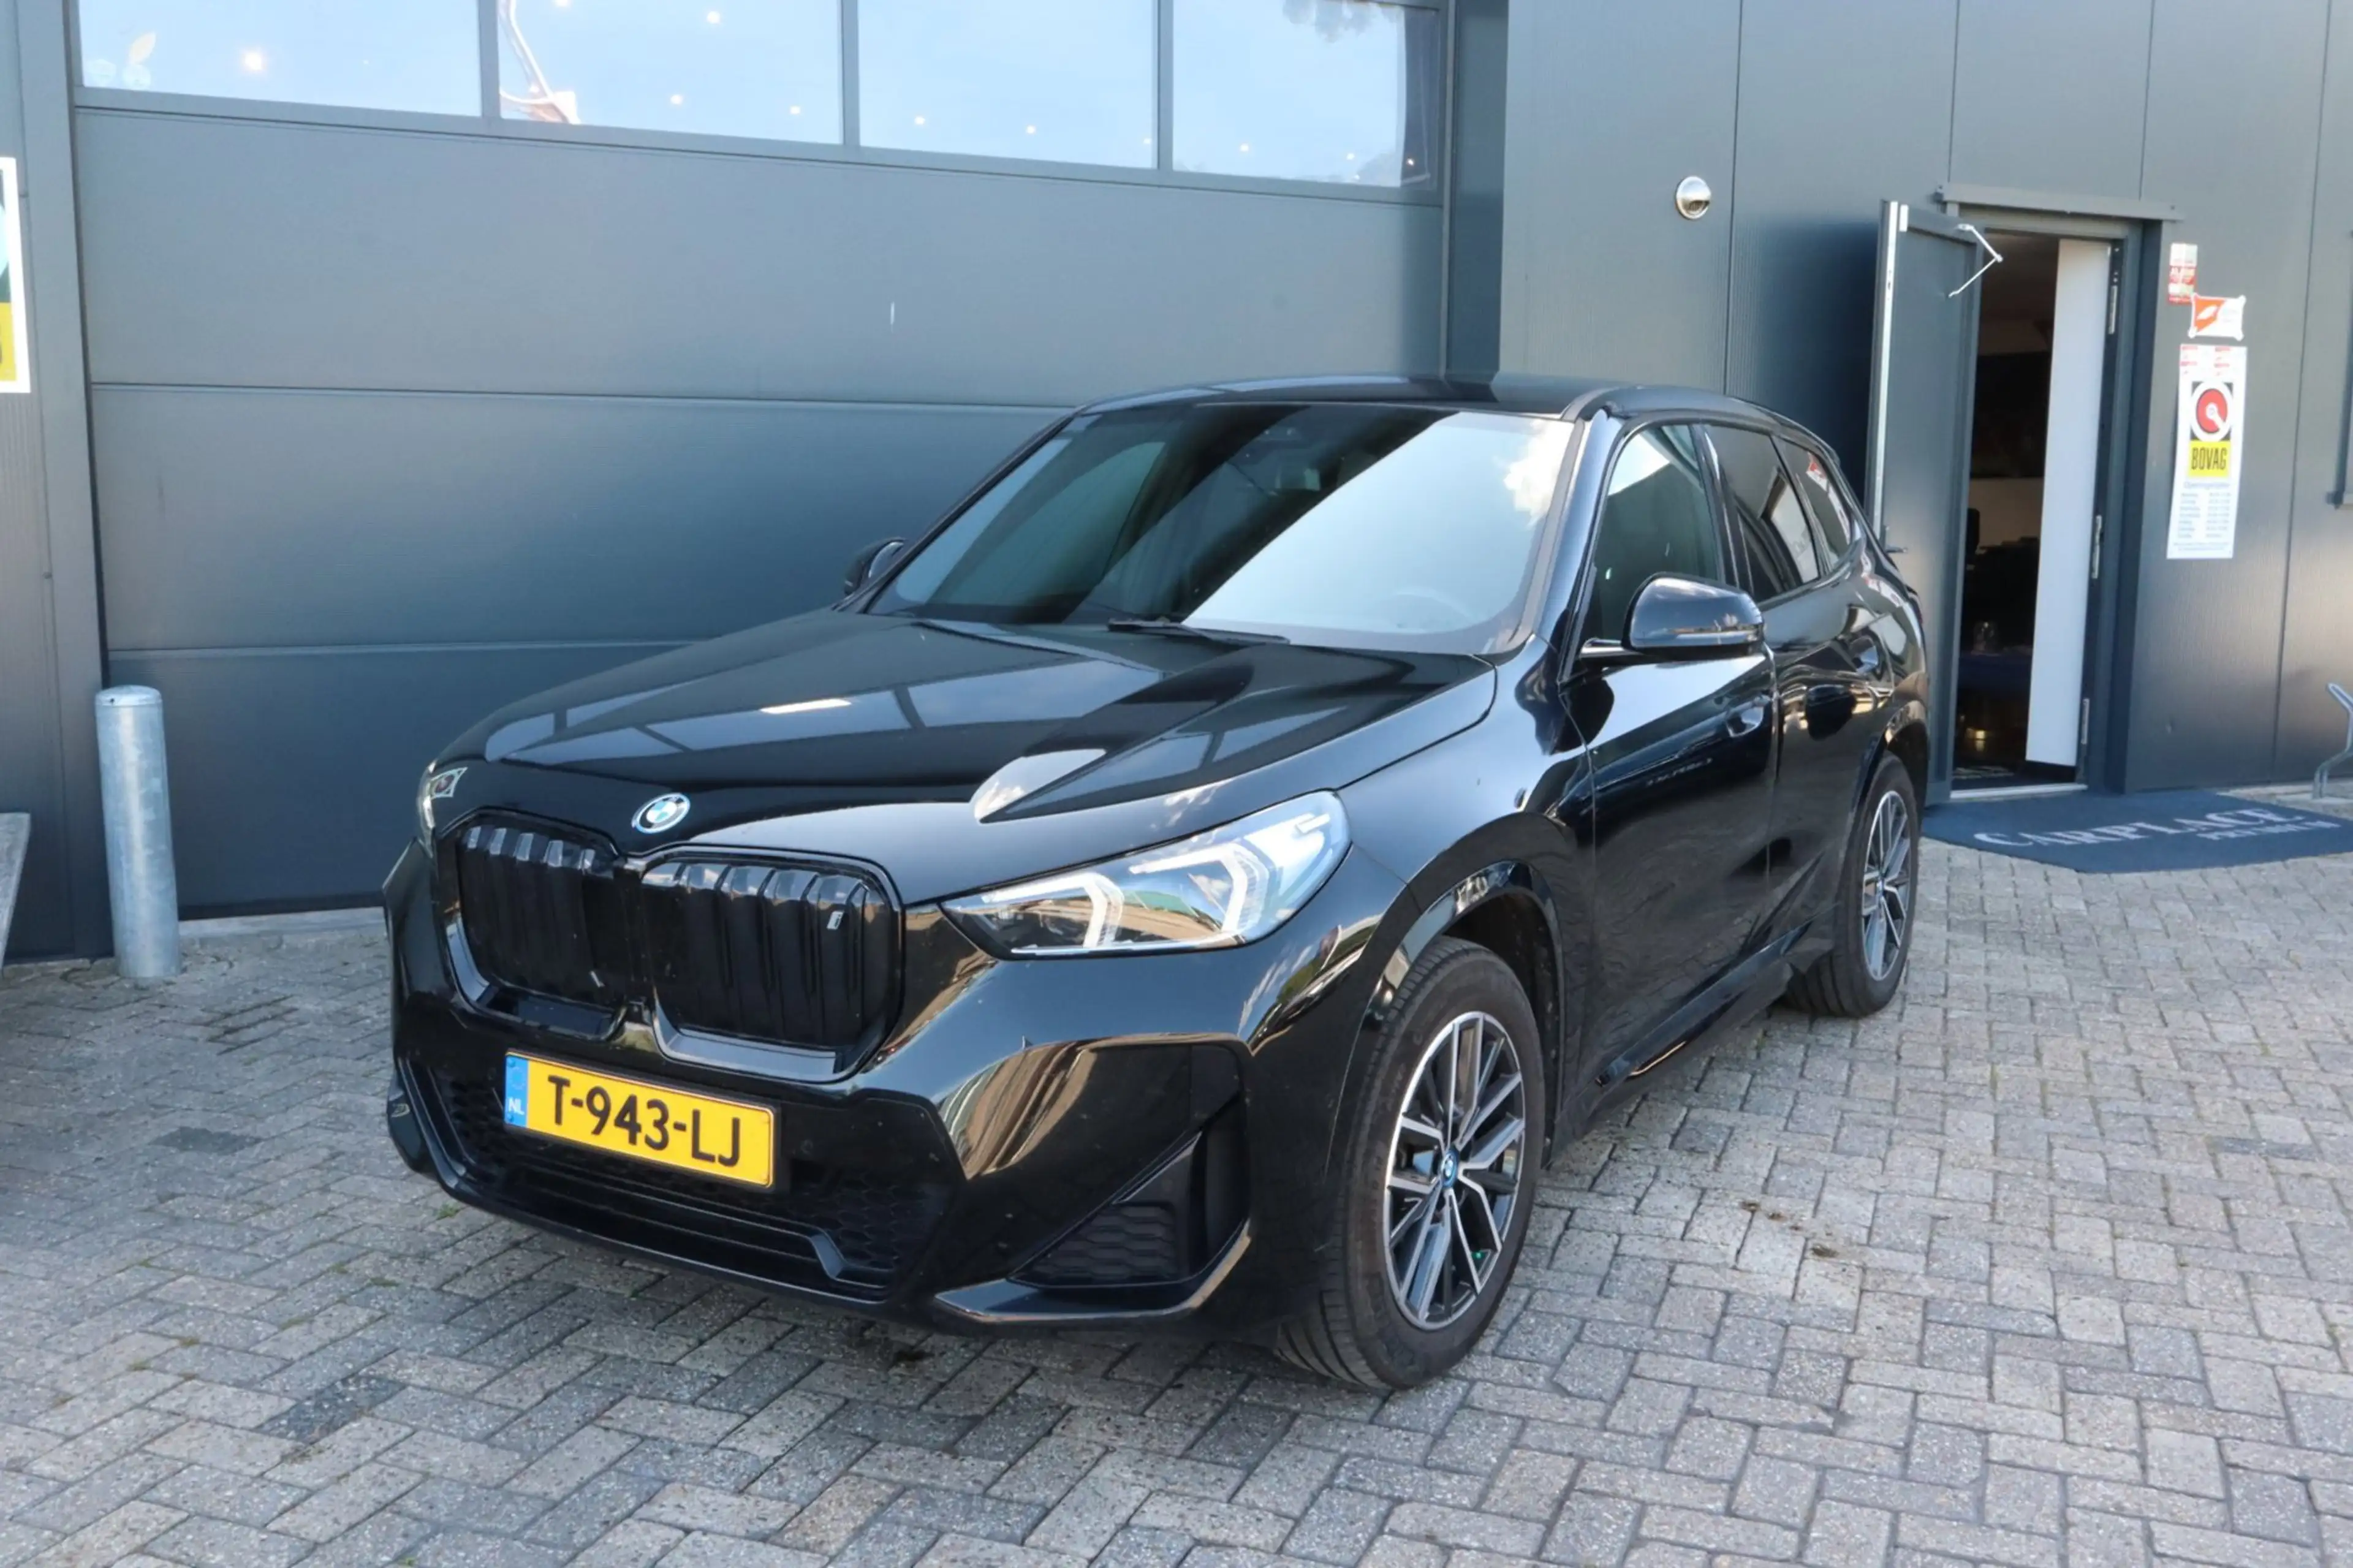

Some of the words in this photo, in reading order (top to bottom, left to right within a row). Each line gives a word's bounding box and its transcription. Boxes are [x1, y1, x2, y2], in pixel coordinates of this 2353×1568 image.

[2191, 447, 2227, 471] BOVAG
[1973, 808, 2305, 847] CARPLACE
[508, 1097, 525, 1116] NL
[547, 1074, 741, 1167] T-943-LJ
